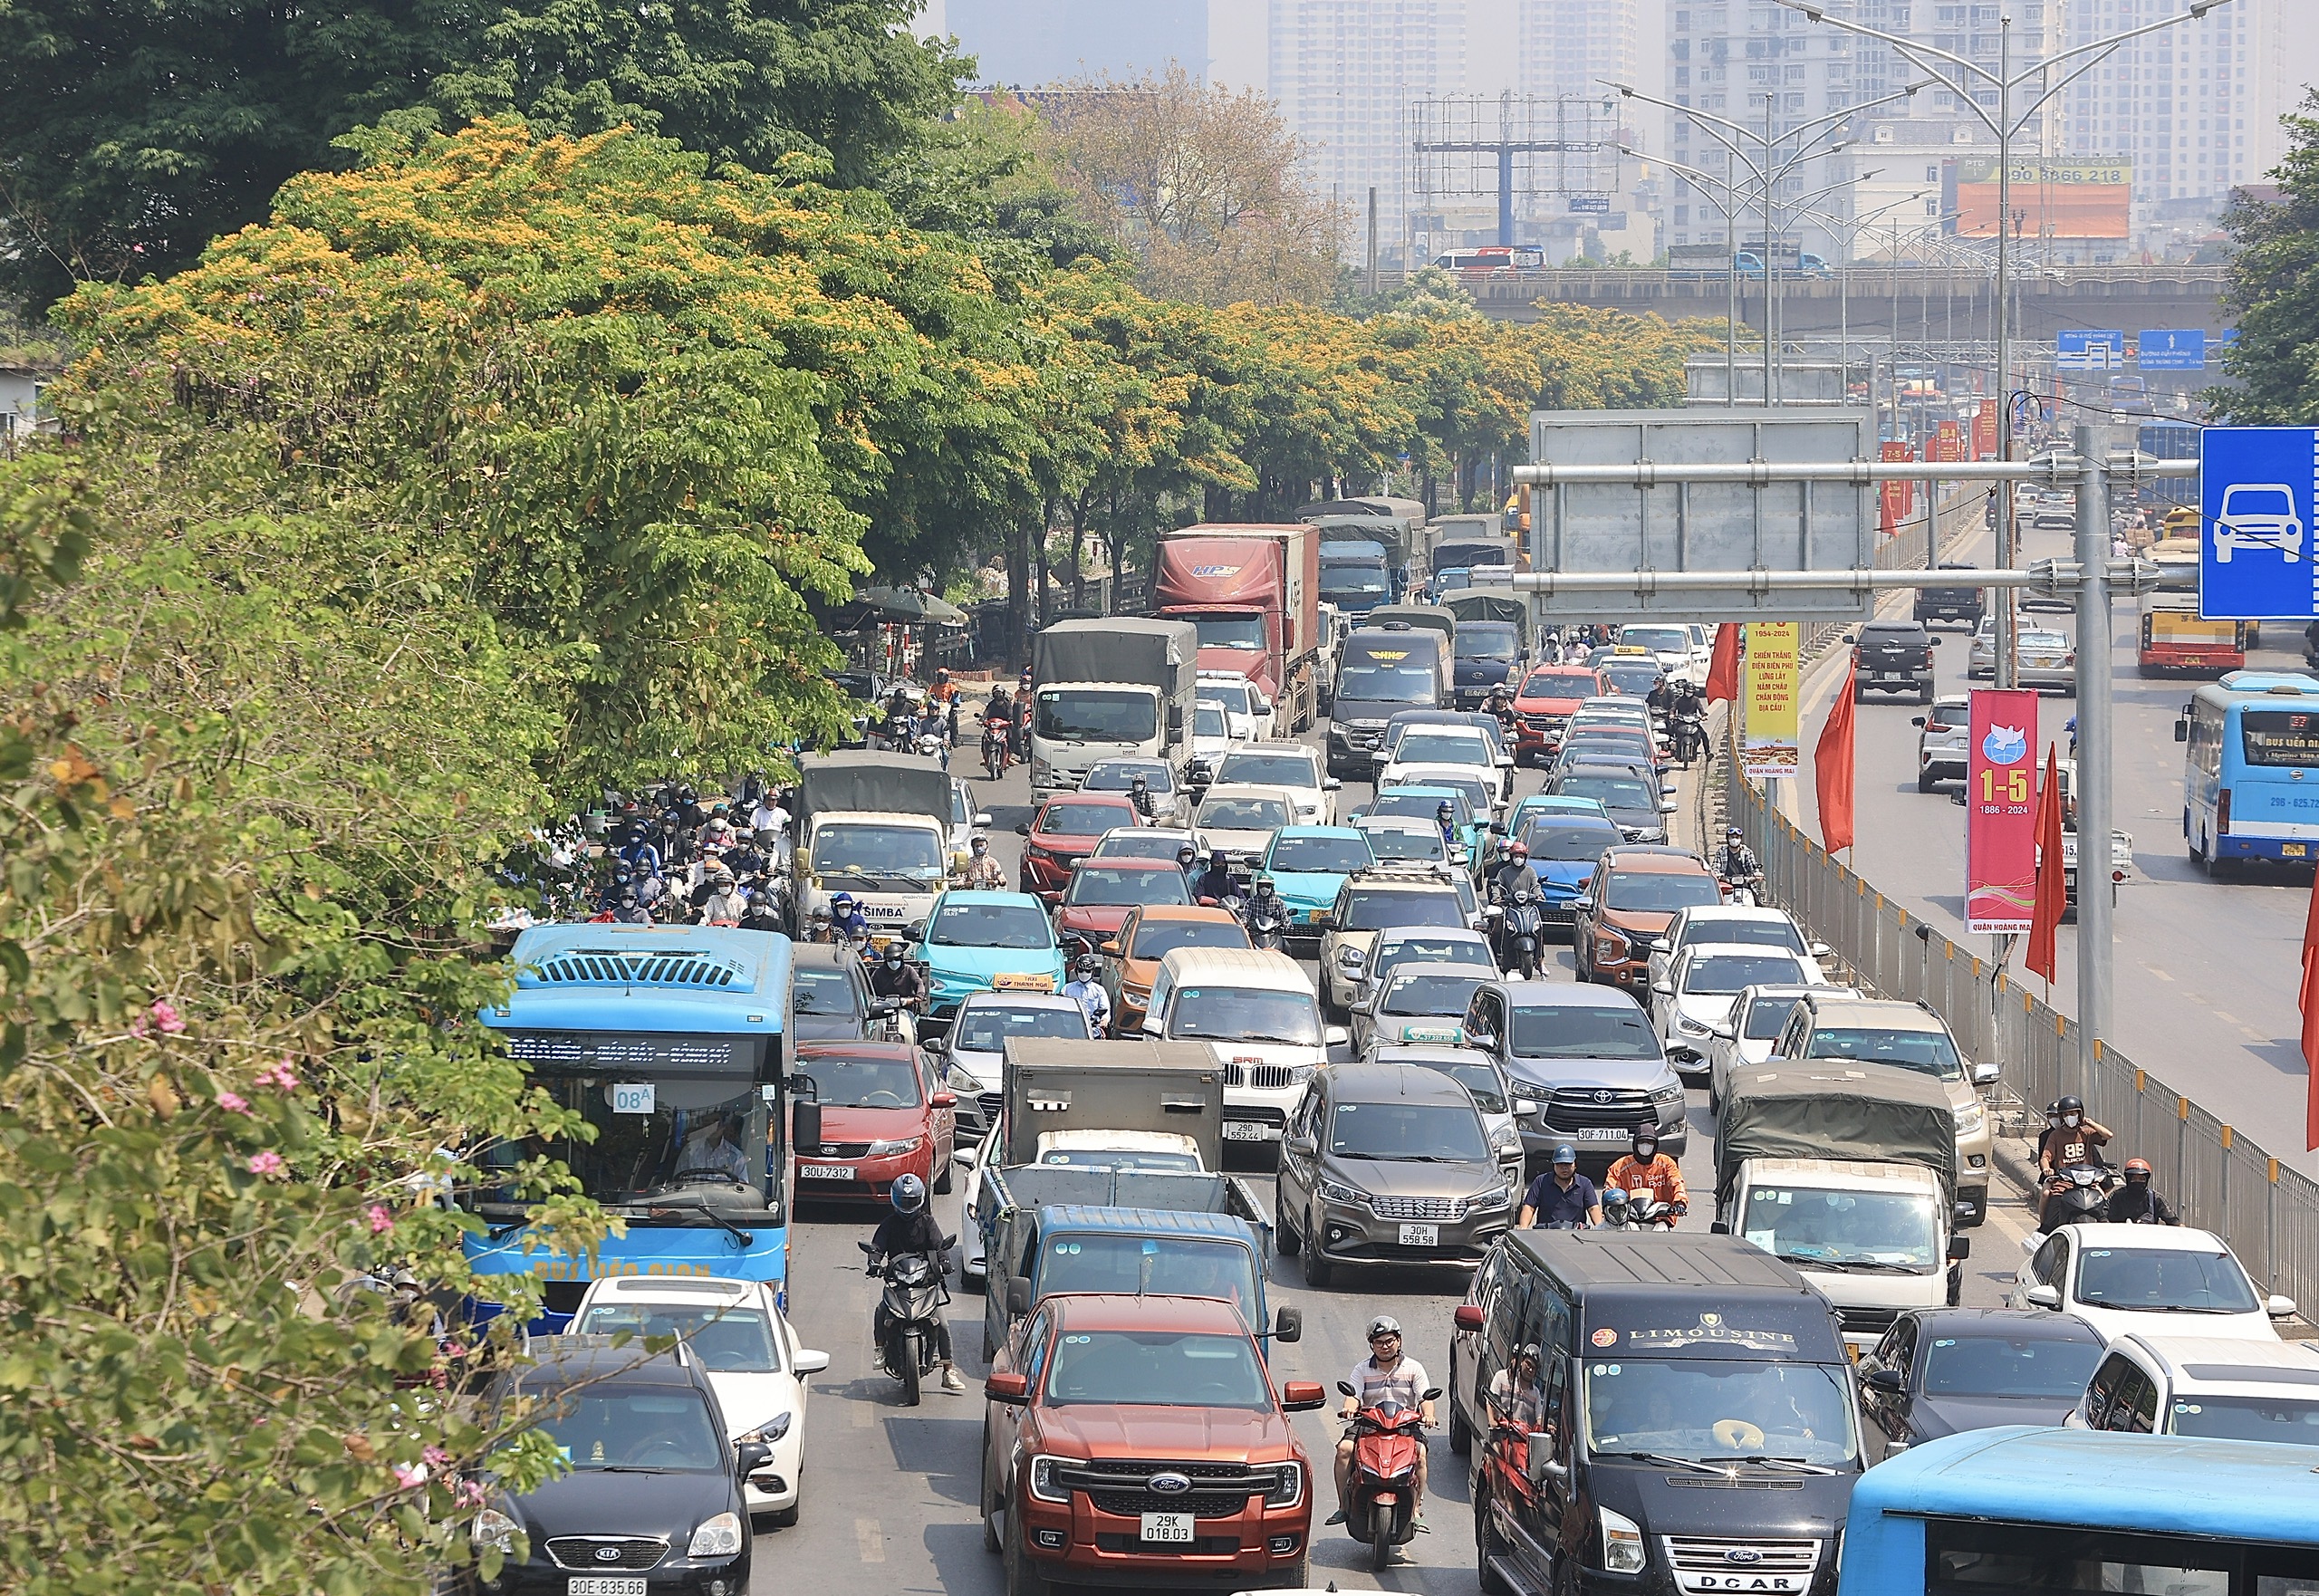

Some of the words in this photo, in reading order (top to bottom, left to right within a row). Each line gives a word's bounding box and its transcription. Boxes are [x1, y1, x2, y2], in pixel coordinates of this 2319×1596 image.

[2088, 170, 2121, 181] 218
[2265, 737, 2284, 747] BUS
[2307, 738, 2319, 748] NI
[1979, 768, 2028, 803] 1-5
[1979, 805, 2000, 814] 1886
[2007, 805, 2028, 814] 2024
[2062, 844, 2077, 856] 15.
[863, 908, 903, 918] SIMBA
[1972, 922, 1992, 932] QUẬN
[1994, 922, 2018, 931] HOÀNG
[2019, 923, 2032, 931] MA
[1230, 1131, 1258, 1139] 552.44
[1579, 1130, 1627, 1139] 30F-711.04
[803, 1167, 849, 1178] 30U-7312
[1410, 1226, 1428, 1235] 30H
[1402, 1235, 1434, 1245] 558.58
[1630, 1328, 1795, 1343] LIMOUSINE
[1159, 1478, 1180, 1490] Ford
[1156, 1515, 1179, 1526] 29K
[1146, 1527, 1188, 1540] 018.03
[599, 1550, 617, 1558] KIA
[1733, 1551, 1755, 1561] Ford
[571, 1580, 644, 1595] 30E-835.66
